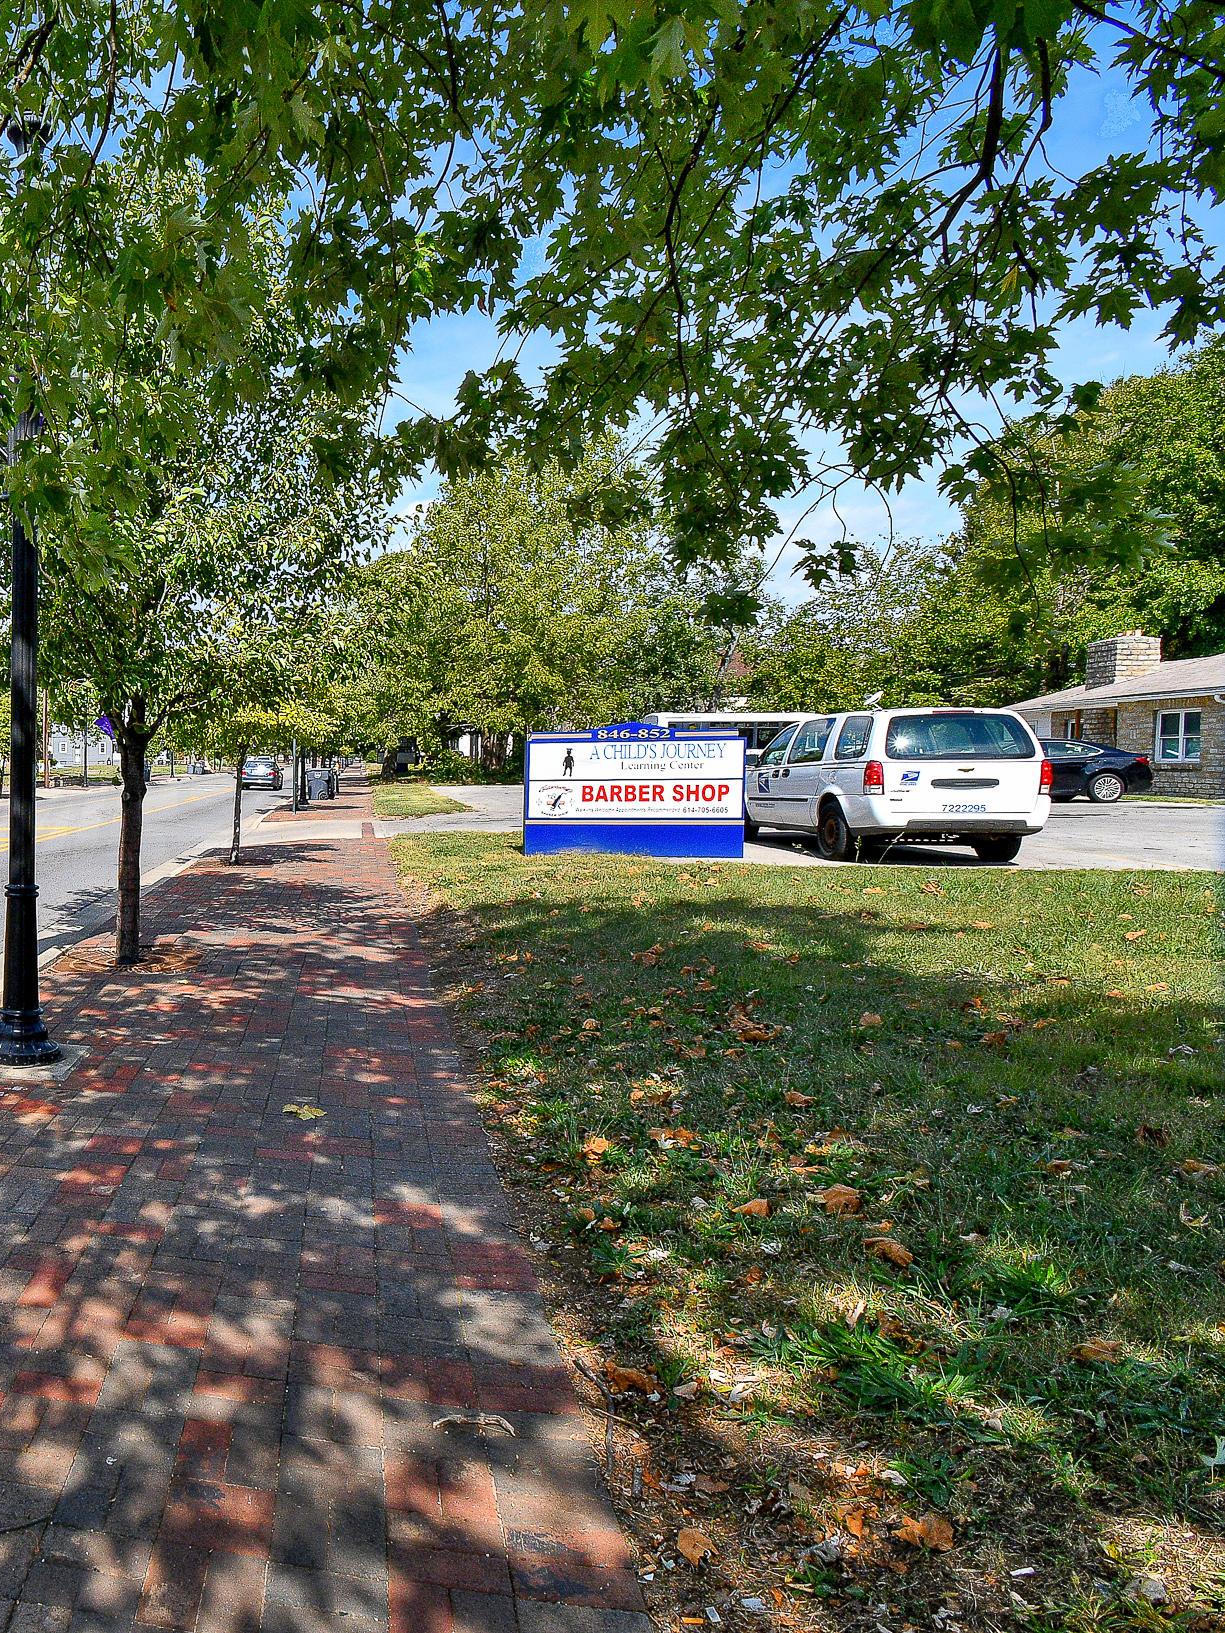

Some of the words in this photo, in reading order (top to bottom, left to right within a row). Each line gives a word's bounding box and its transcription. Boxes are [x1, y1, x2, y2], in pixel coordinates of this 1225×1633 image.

[597, 728, 671, 739] 846-852
[590, 745, 600, 760] A
[603, 743, 657, 760] CHILD'S
[660, 743, 727, 759] JOURNEY
[621, 761, 666, 772] Learning
[669, 760, 704, 770] Center
[581, 784, 665, 802] BARBER
[672, 784, 730, 802] SHOP
[682, 806, 729, 814] 614-705-6605
[941, 804, 986, 813] 7222295
